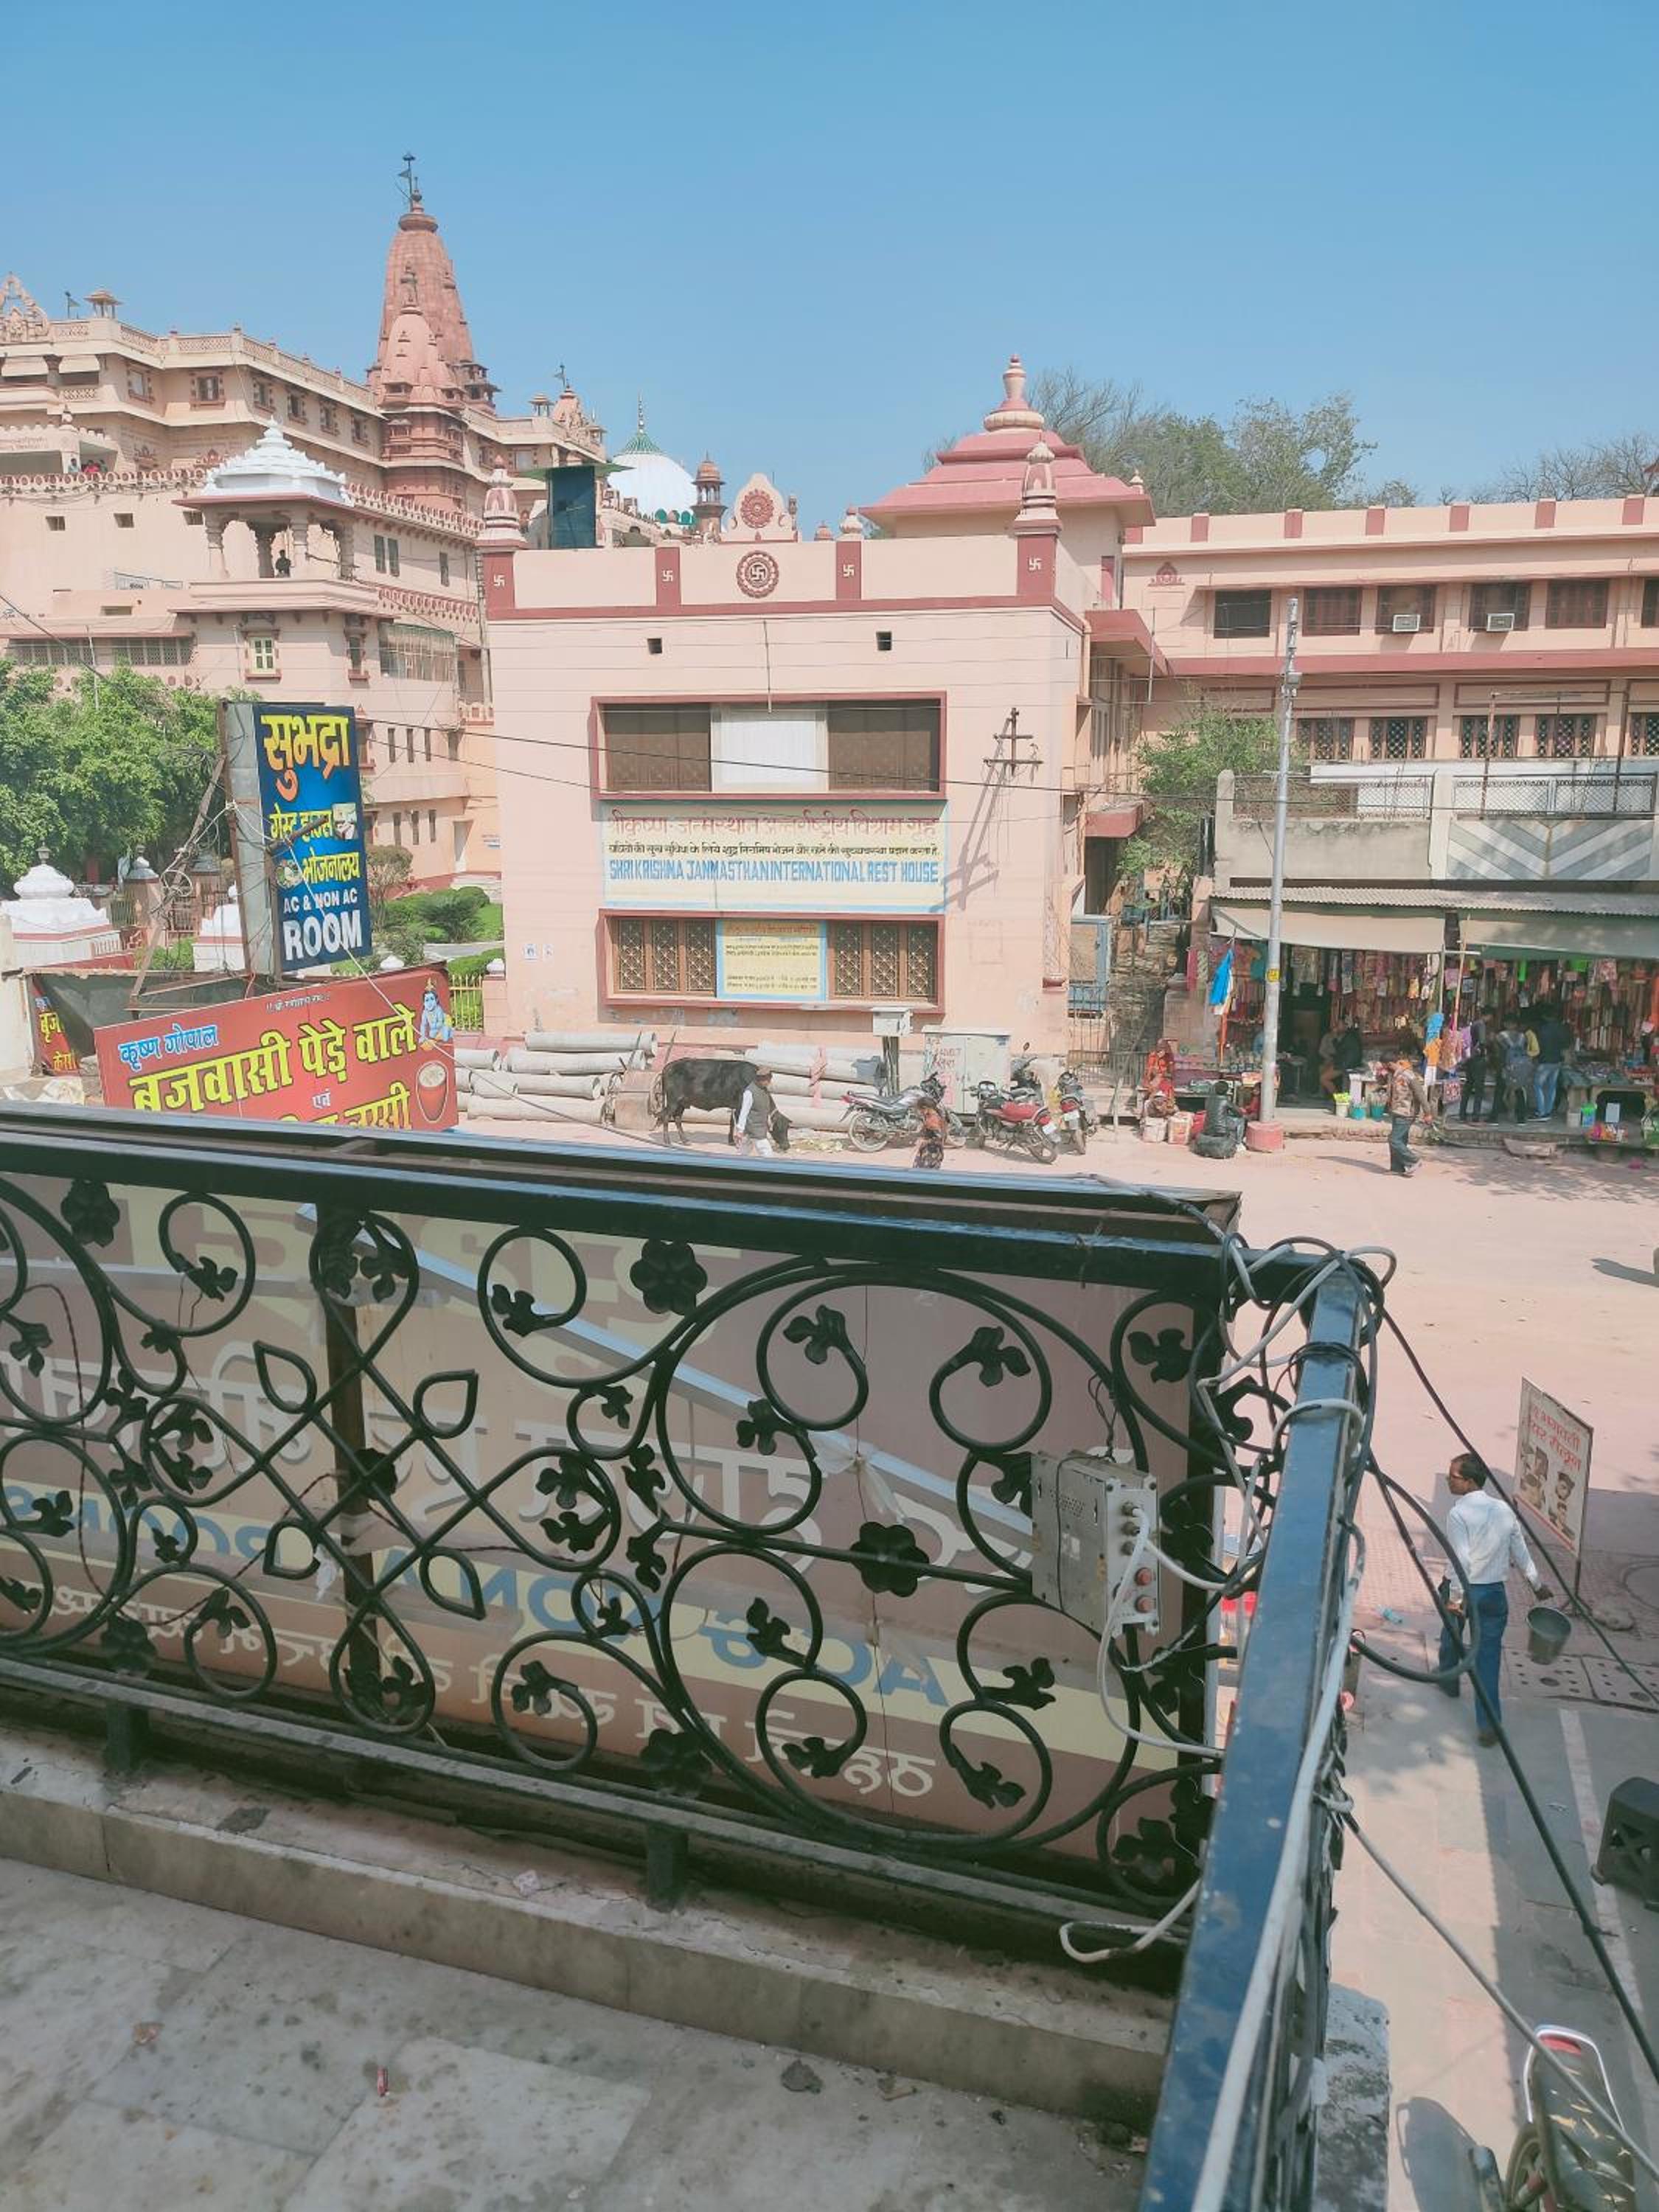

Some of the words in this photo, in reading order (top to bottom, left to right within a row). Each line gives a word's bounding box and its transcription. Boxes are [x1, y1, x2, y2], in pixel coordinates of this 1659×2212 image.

[261, 714, 350, 801] सुभद्रा
[302, 846, 361, 883] भोजनालय
[689, 841, 700, 853] के
[868, 861, 897, 883] REST
[900, 860, 939, 883] HOUSE
[283, 896, 299, 914] AC
[303, 894, 311, 911] &
[314, 890, 340, 908] NON
[282, 909, 363, 961] ROOM
[118, 1037, 161, 1071] कृष्ण
[164, 1023, 219, 1054] गोपाल
[298, 1018, 347, 1083] पेड़े
[352, 1001, 417, 1064] वाले
